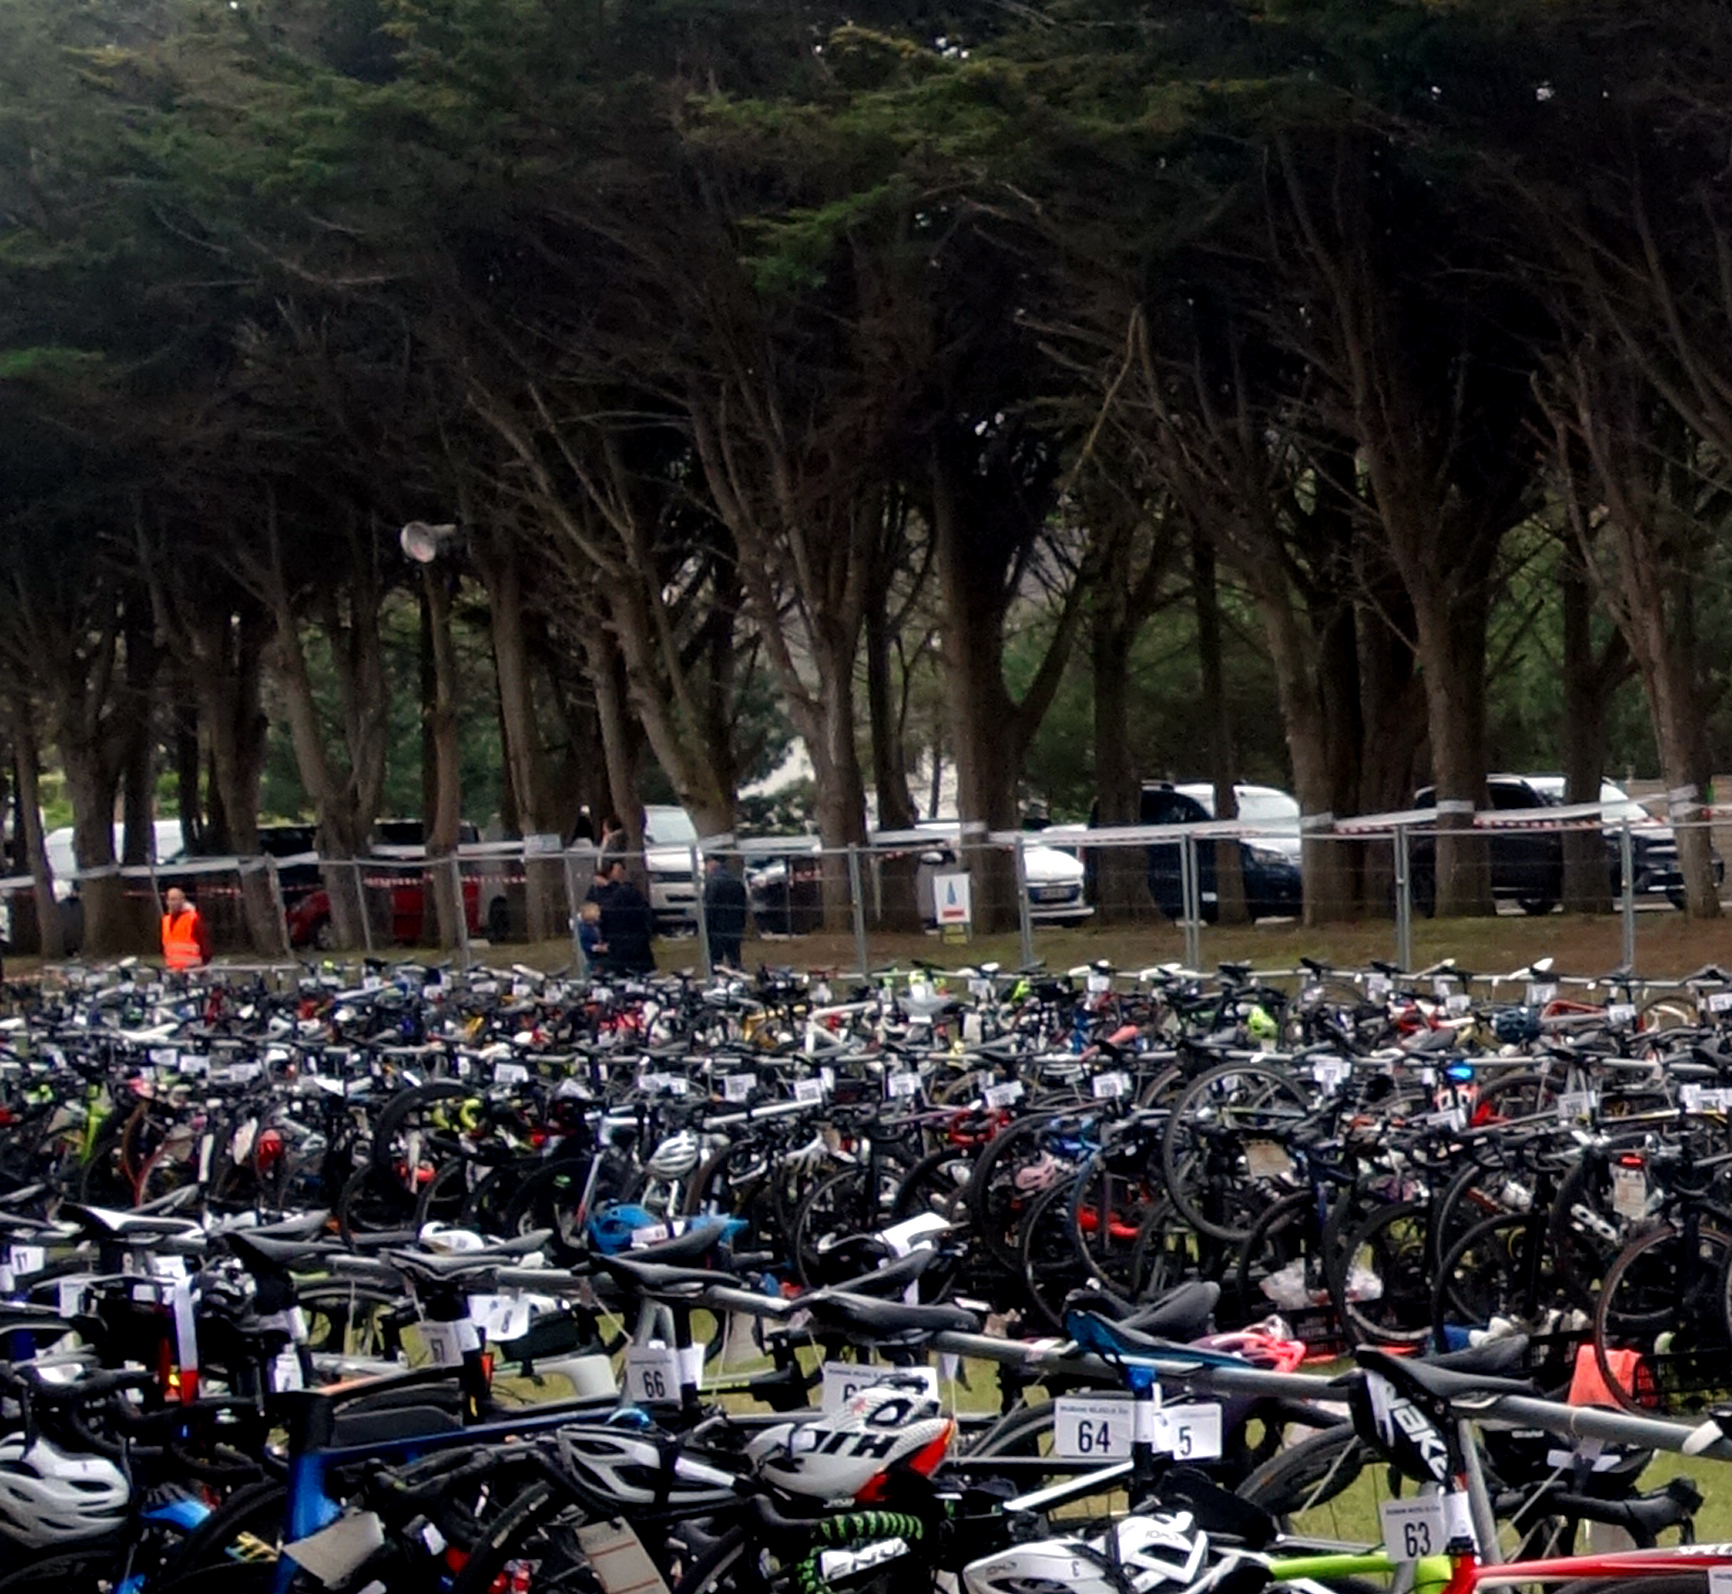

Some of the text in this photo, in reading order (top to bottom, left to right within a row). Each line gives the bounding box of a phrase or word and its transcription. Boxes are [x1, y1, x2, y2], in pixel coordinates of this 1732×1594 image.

[1077, 1420, 1111, 1454] 64
[1178, 1425, 1193, 1457] 5
[1403, 1521, 1432, 1558] 63
